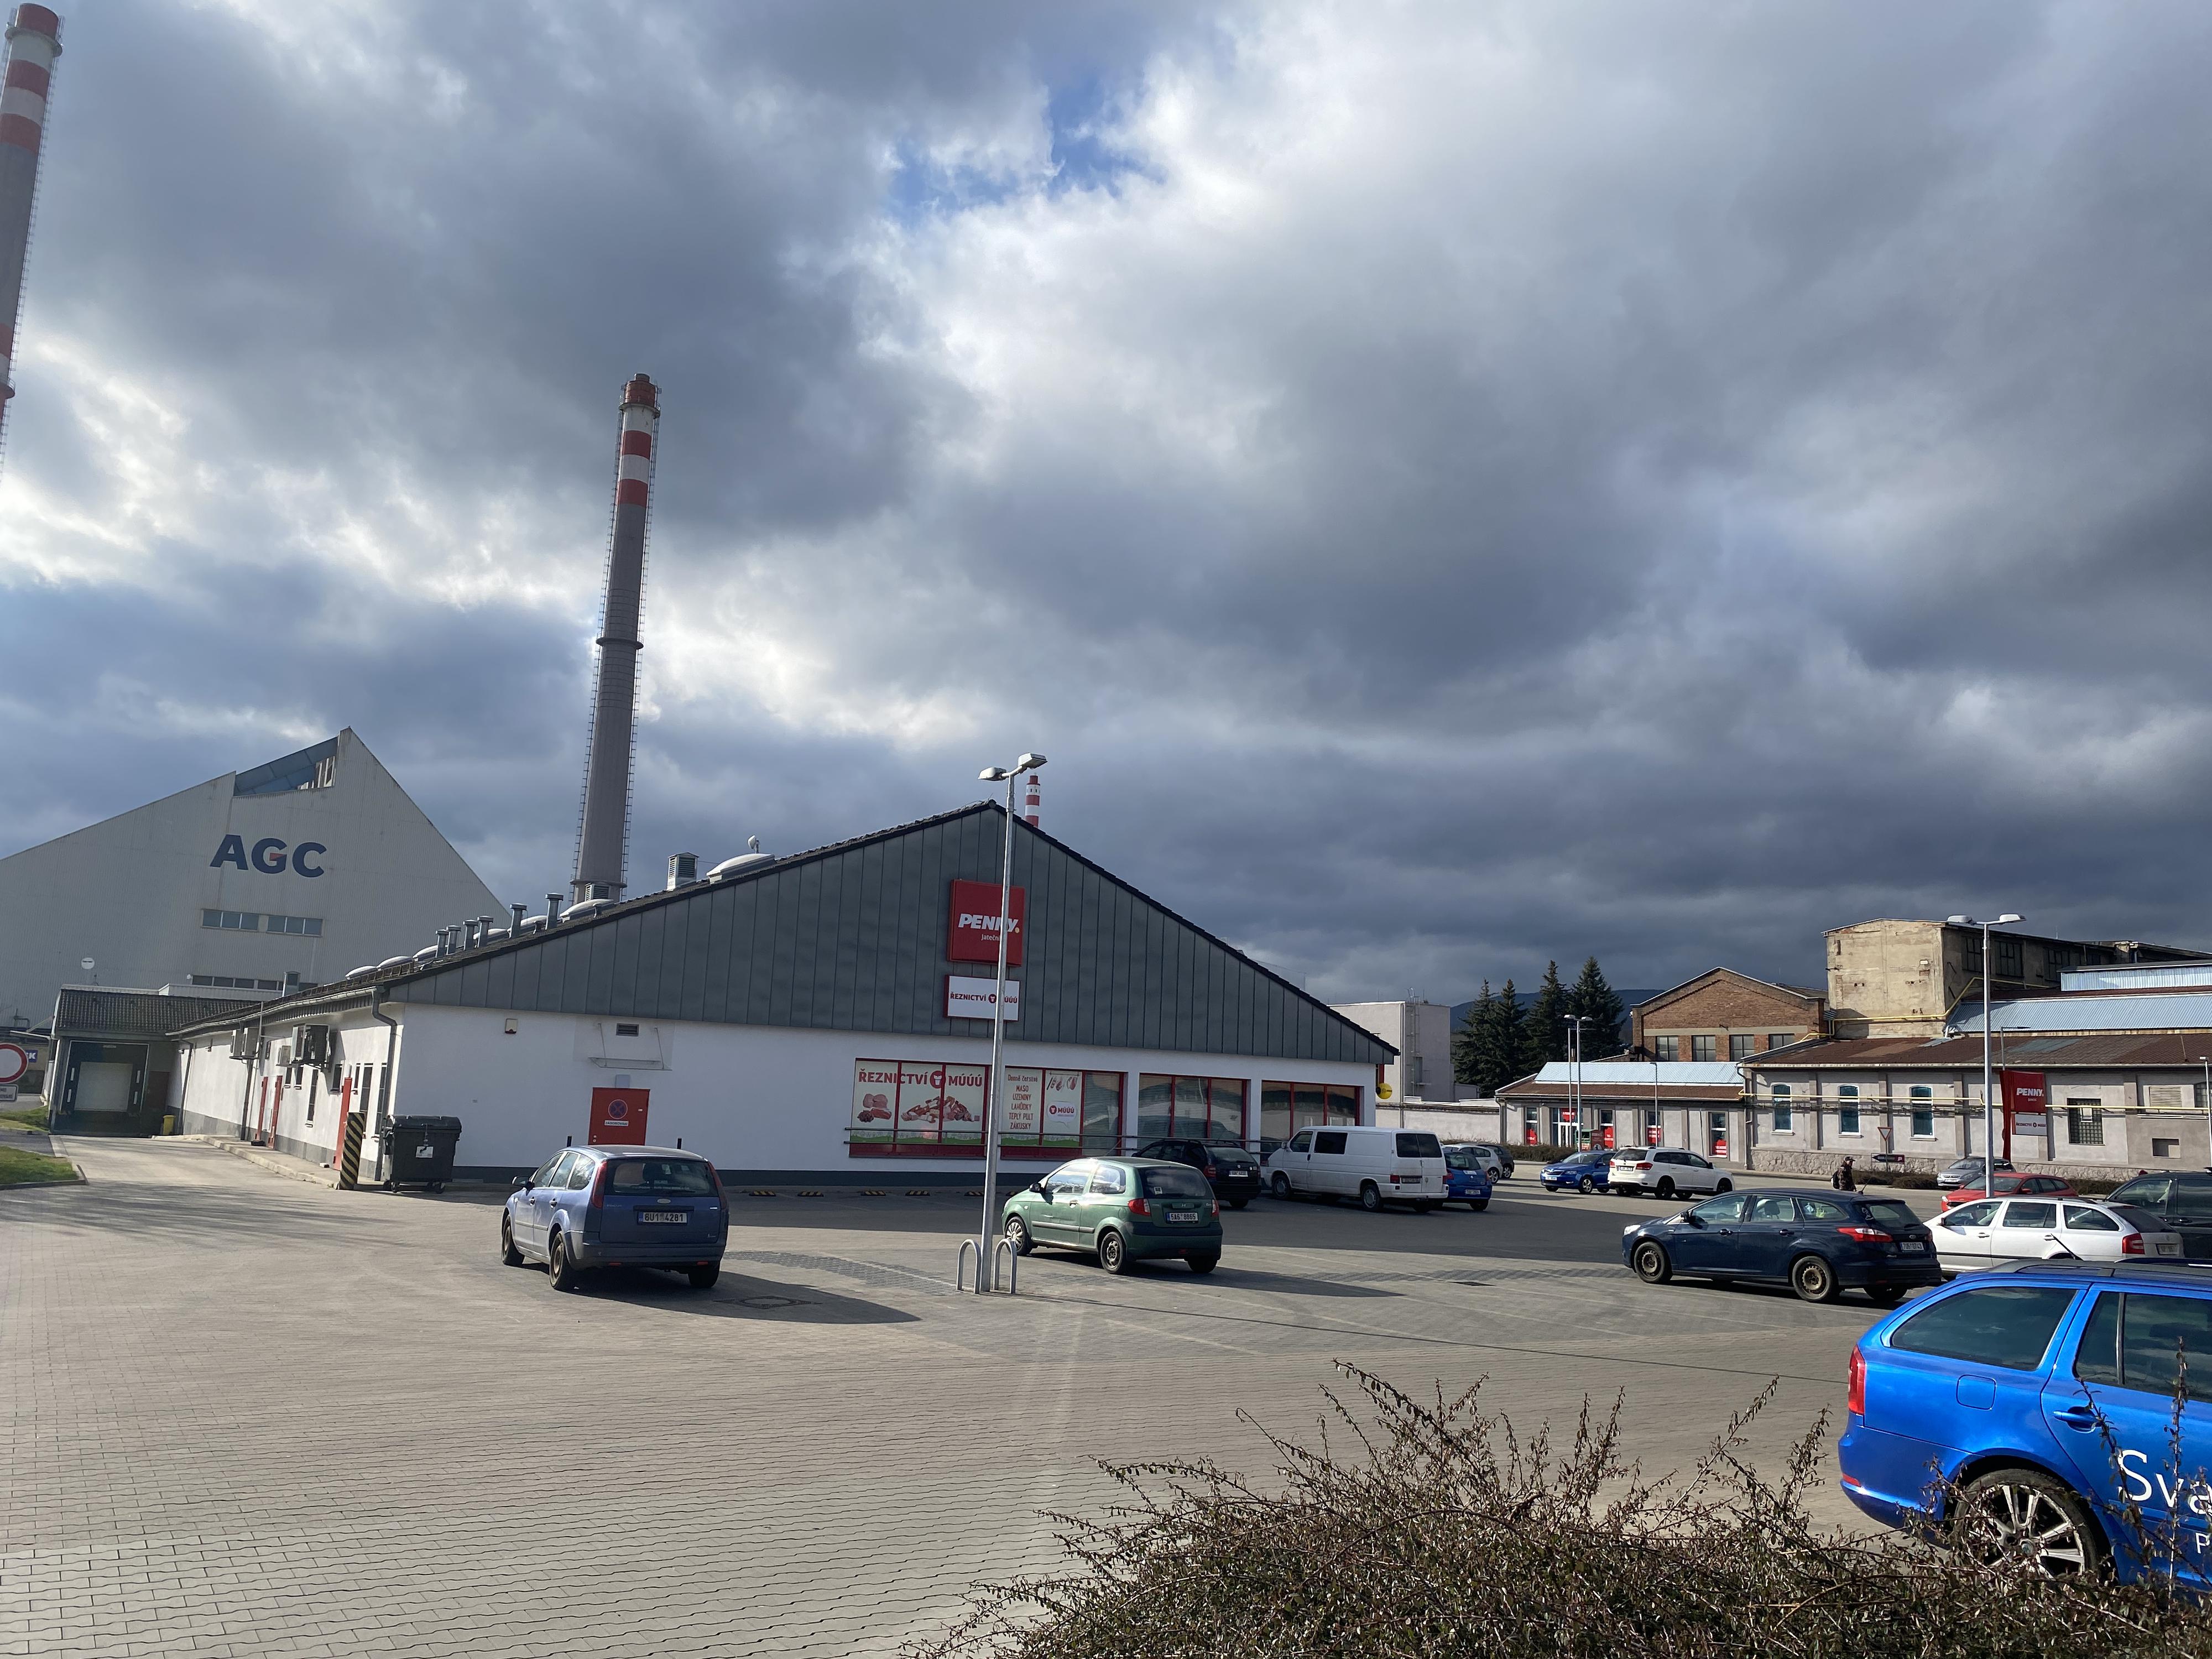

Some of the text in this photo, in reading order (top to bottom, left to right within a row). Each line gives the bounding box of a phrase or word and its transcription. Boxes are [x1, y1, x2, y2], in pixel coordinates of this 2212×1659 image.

[210, 834, 327, 878] AGC
[950, 992, 986, 1001] ŘEZNICTVÍ
[859, 1068, 982, 1087] ŘEZNICTVÍ MÚÚÚ
[1009, 1112, 1021, 1120] TEPLÝ
[665, 1213, 684, 1222] 4281
